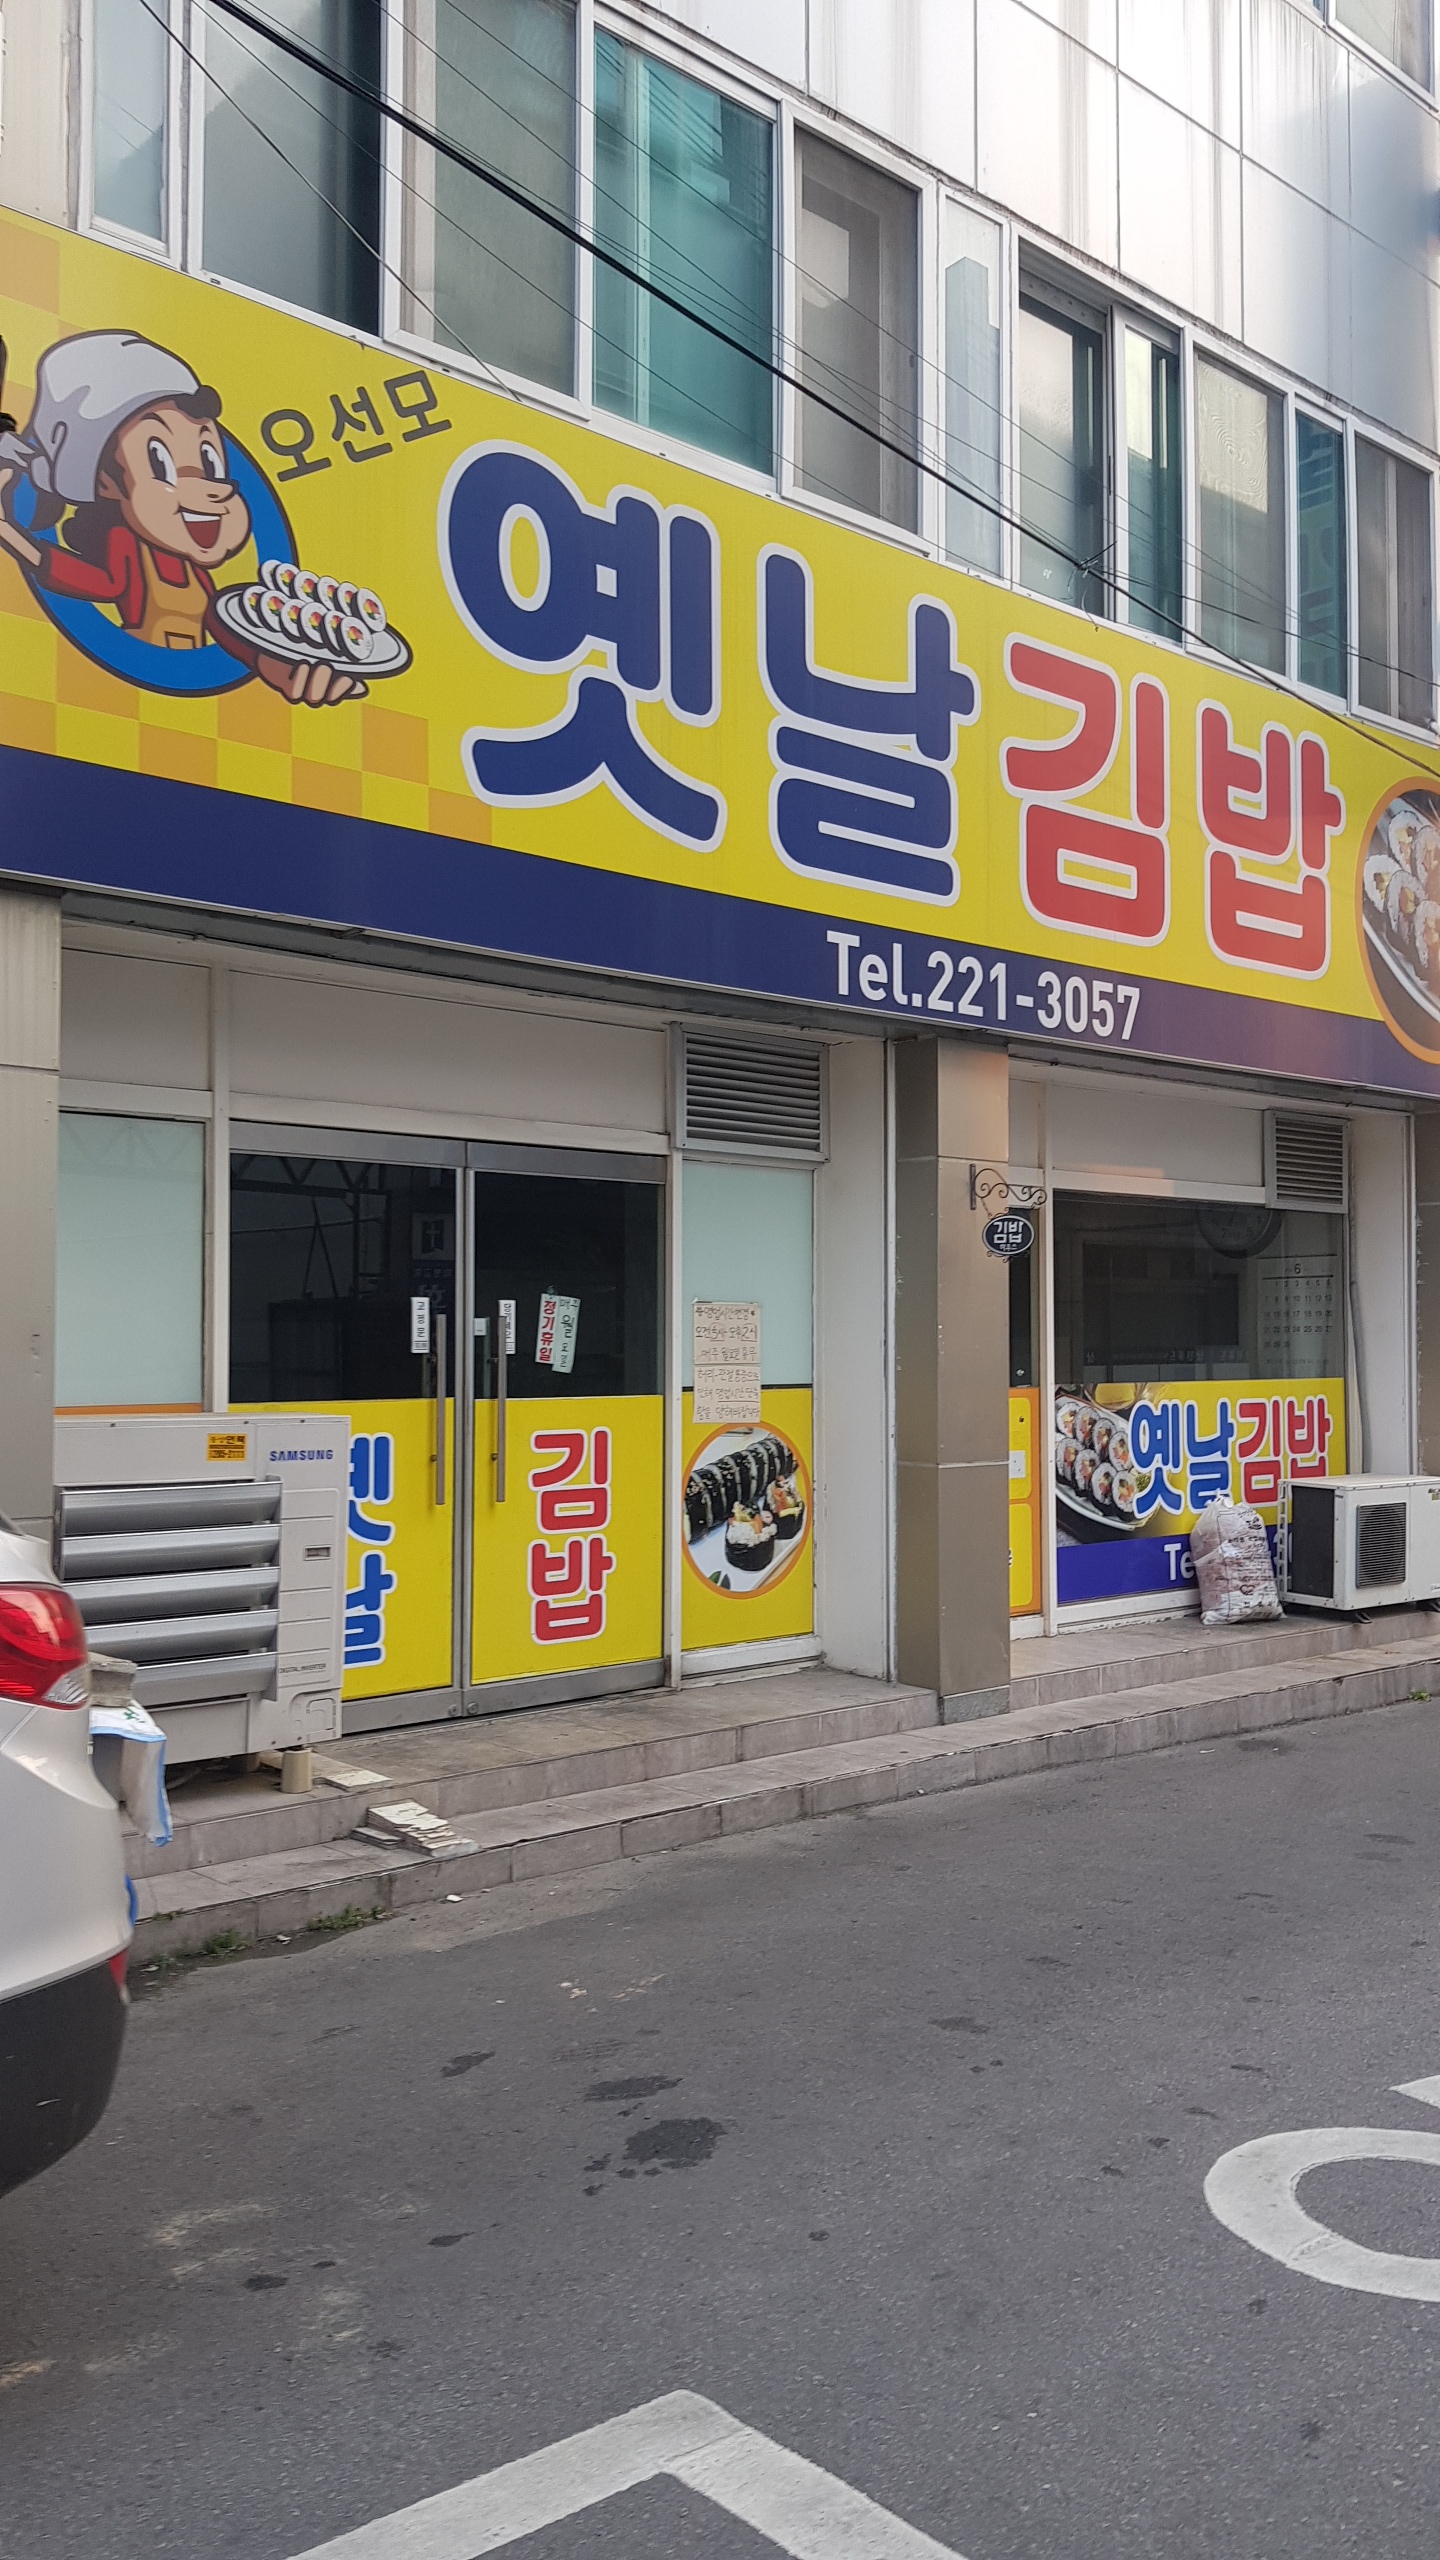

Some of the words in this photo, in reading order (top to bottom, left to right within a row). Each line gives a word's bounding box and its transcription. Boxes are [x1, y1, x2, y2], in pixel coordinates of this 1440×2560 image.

[260, 371, 452, 482] 오선모
[826, 930, 1141, 1041] Tel.221-3057
[993, 1221, 1025, 1243] 김밥
[1294, 1263, 1301, 1275] 6
[539, 1300, 557, 1362] 정기휴일
[269, 1449, 333, 1462] SAMSUNG
[529, 1427, 617, 1646] 김밥
